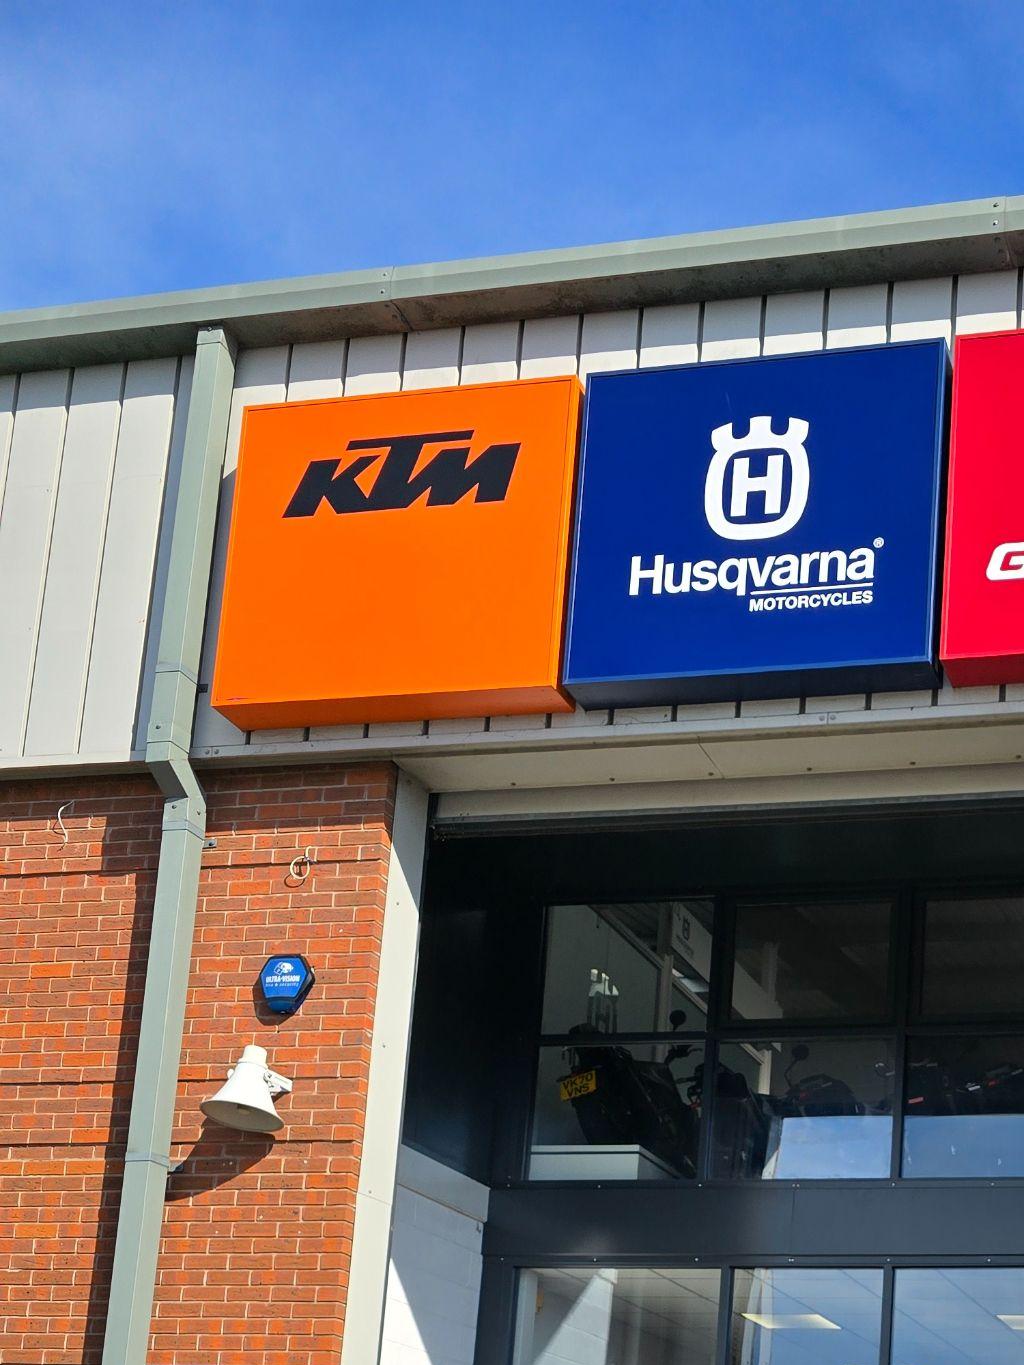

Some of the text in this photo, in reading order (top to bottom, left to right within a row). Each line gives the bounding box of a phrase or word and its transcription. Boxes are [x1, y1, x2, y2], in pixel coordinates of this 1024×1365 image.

[281, 429, 522, 519] KTM
[748, 590, 874, 612] MOTORCYCLES
[566, 1082, 590, 1098] VNS
